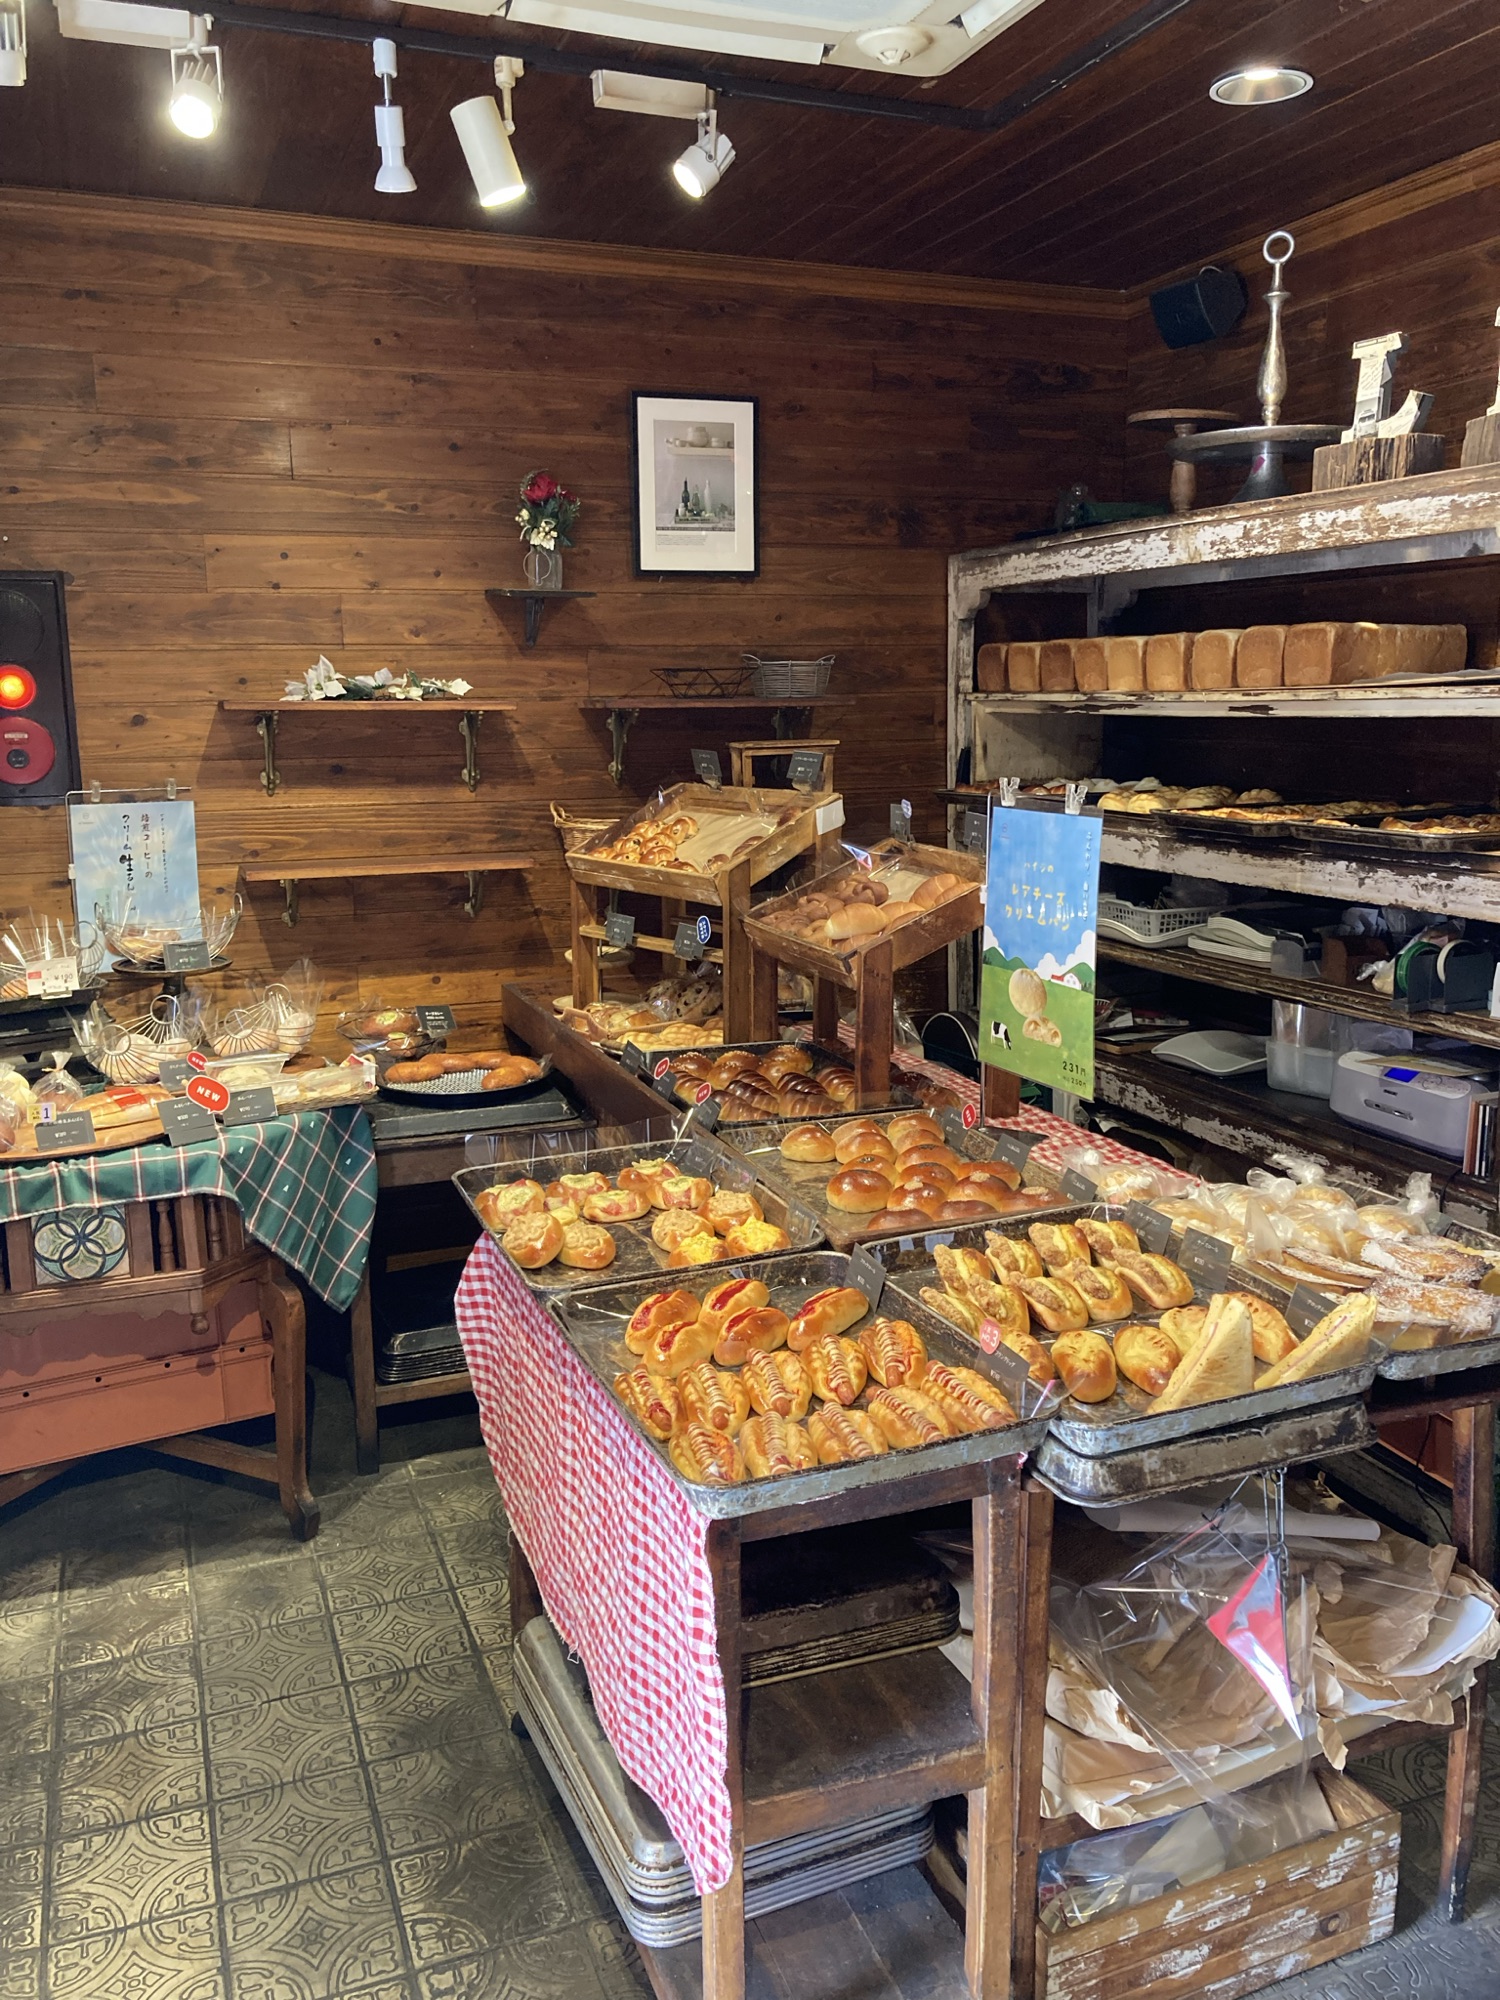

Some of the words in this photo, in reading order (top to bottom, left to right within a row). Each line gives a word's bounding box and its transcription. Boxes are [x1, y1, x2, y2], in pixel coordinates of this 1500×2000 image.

[1012, 883, 1066, 906] レアチーズ
[1062, 1060, 1086, 1077] 231円
[196, 1085, 221, 1103] NEW
[43, 1107, 50, 1119] 1
